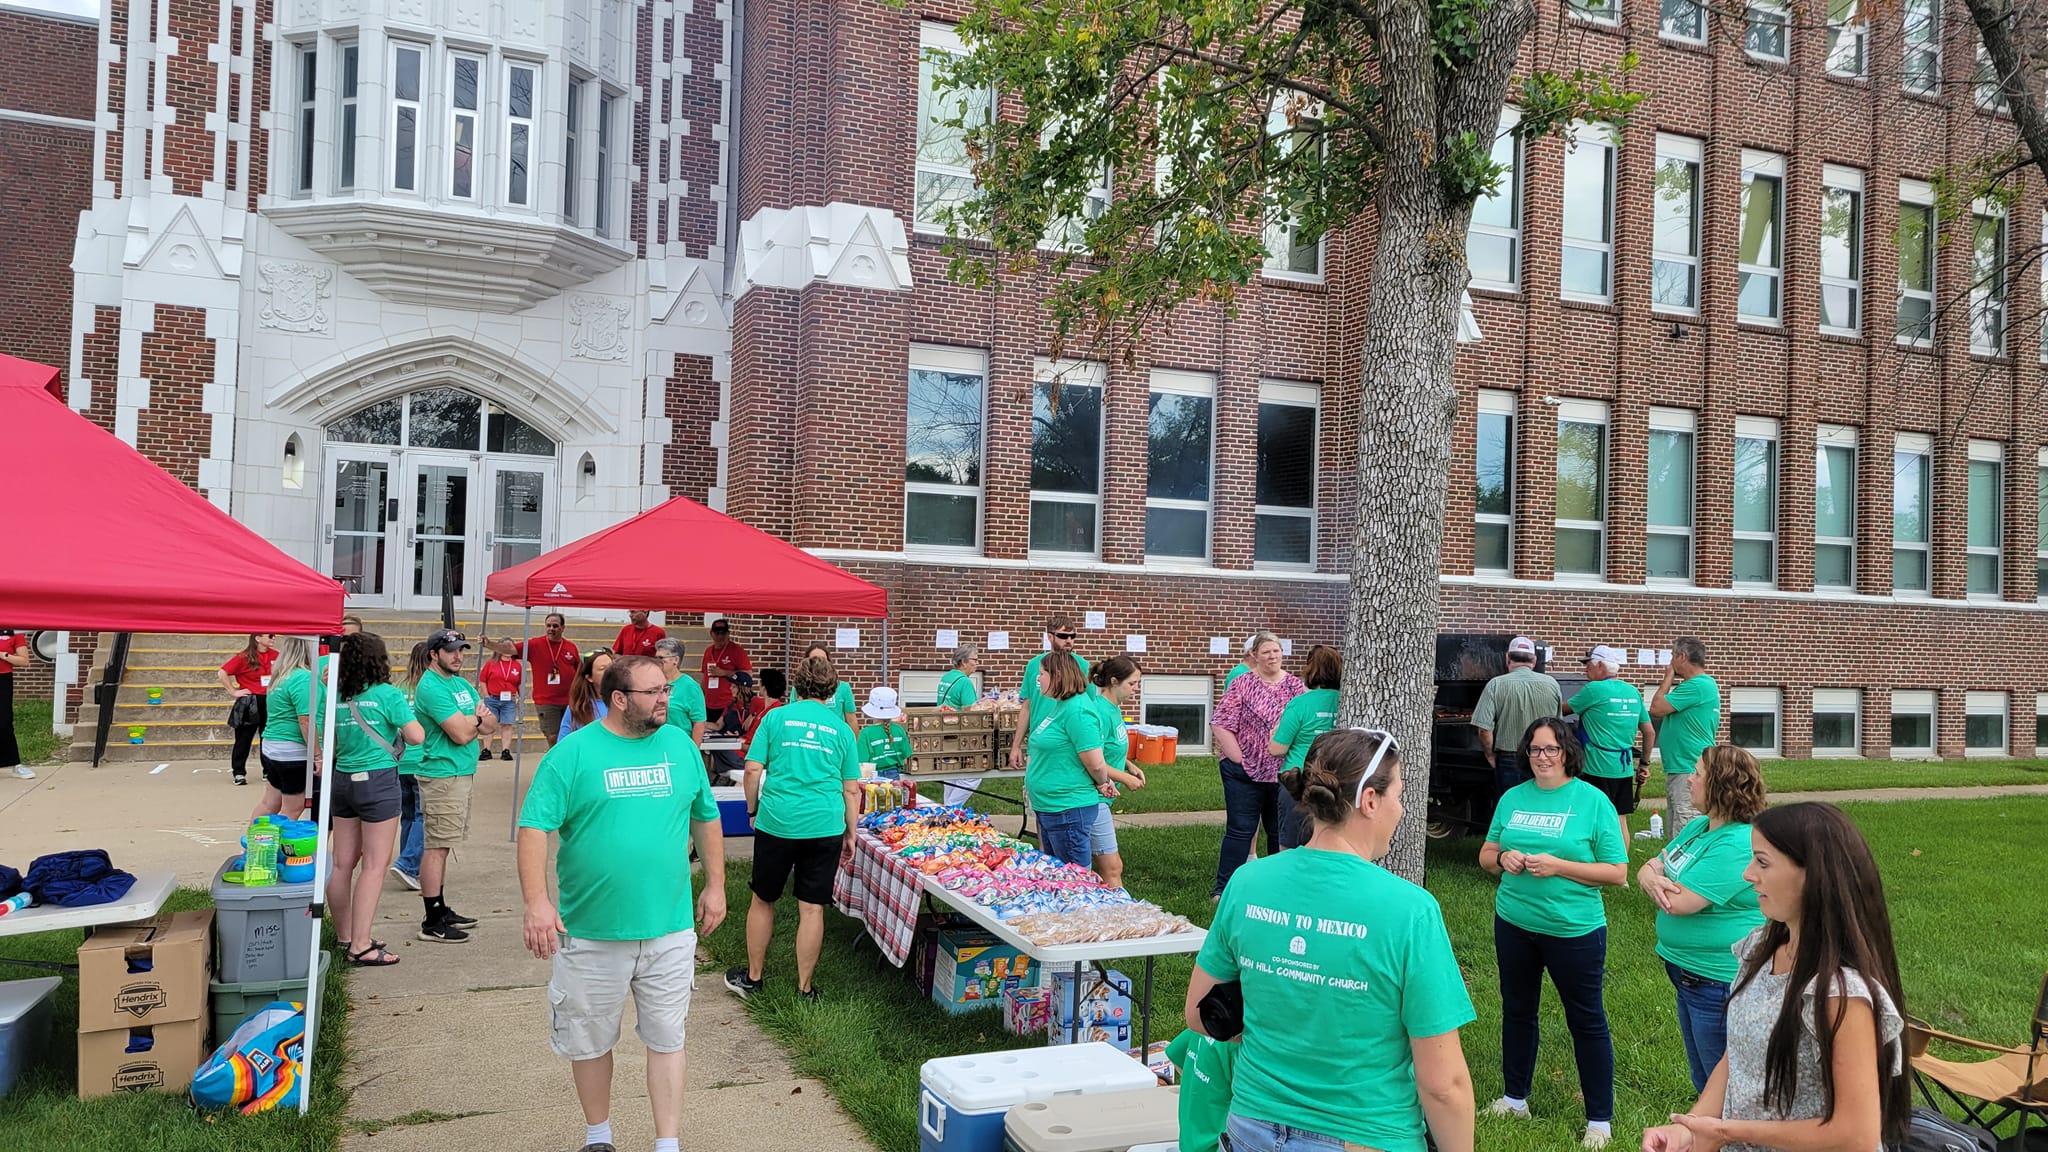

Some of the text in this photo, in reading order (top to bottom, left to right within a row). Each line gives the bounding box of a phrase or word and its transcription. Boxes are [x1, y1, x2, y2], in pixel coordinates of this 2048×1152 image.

[339, 461, 350, 473] 7
[608, 768, 666, 788] INFLUENCER
[1511, 813, 1562, 828] INFLUENCER
[1245, 904, 1368, 939] MISSION TO MEXICO
[1272, 956, 1320, 971] CO-SPONSORED BY
[1256, 962, 1274, 974] HILL
[1276, 966, 1326, 986] COMMUNITY
[1328, 977, 1368, 991] CHURCH
[121, 992, 159, 1003] Hendrix
[119, 1071, 157, 1082] Hendrix
